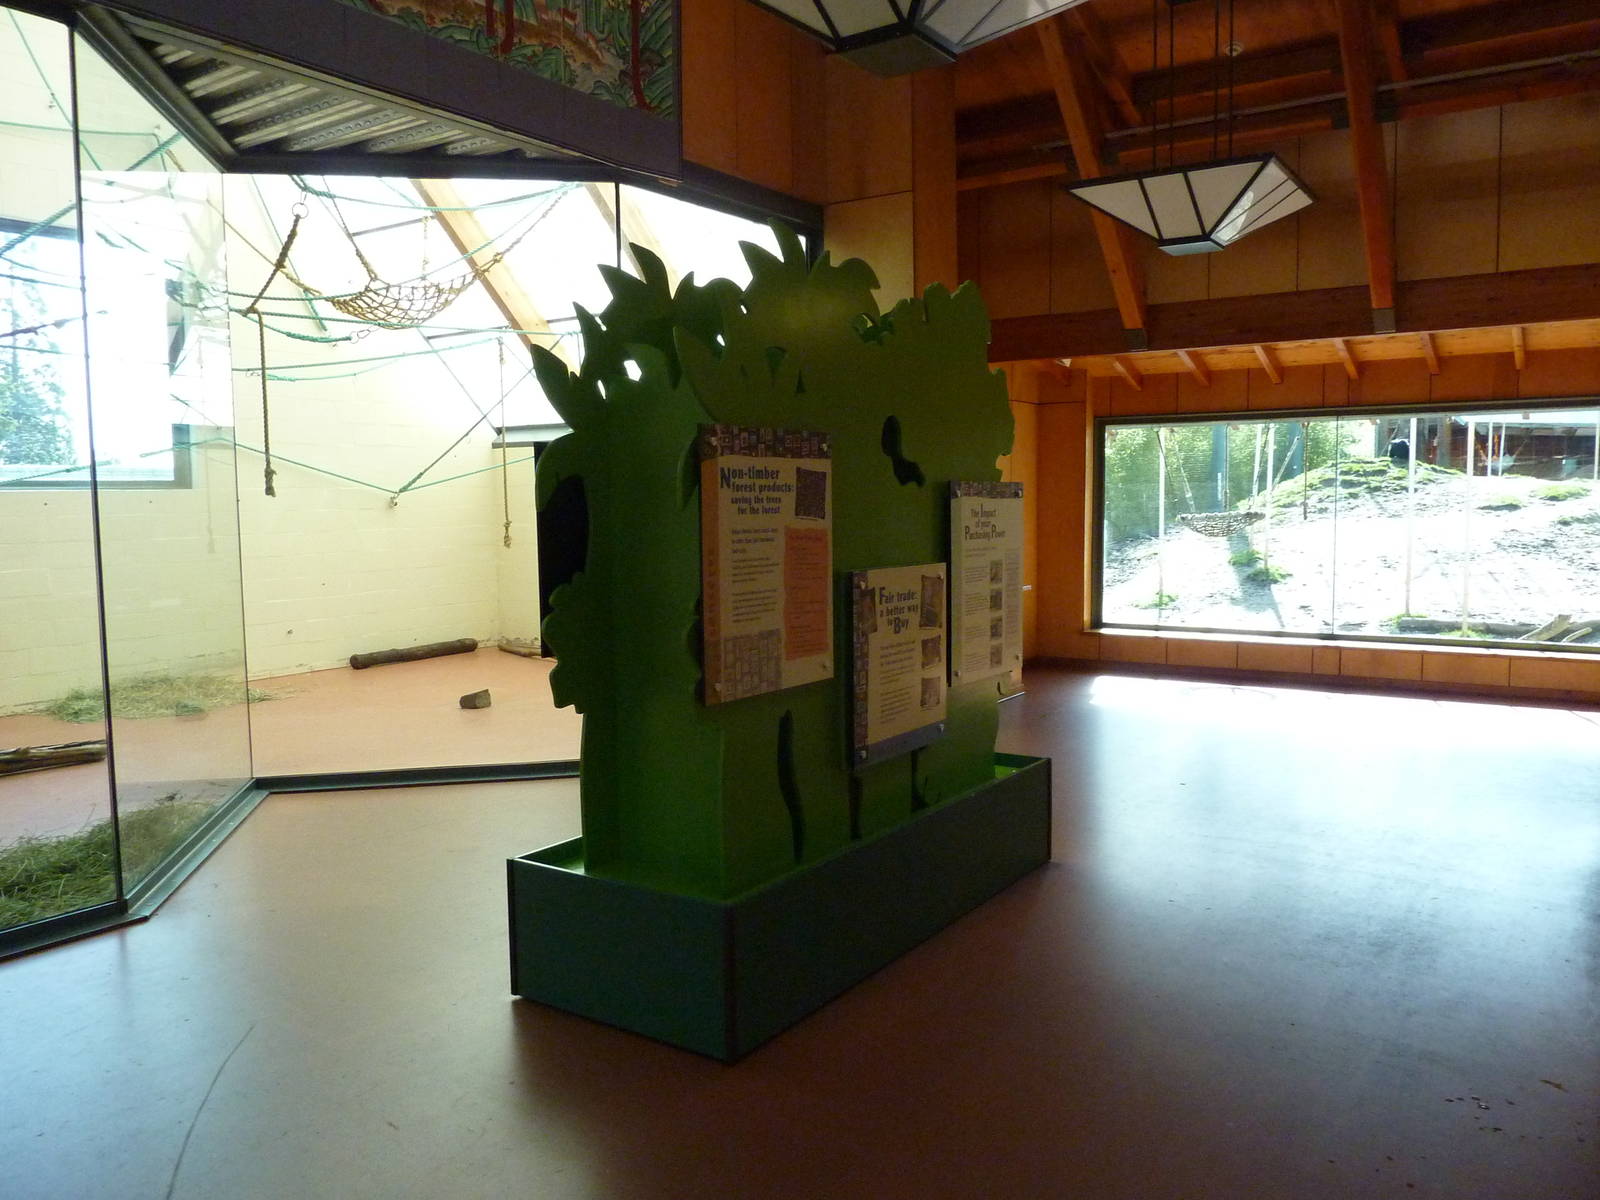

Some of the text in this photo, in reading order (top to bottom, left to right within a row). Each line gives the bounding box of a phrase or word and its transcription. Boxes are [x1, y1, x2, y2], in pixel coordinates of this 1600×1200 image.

[720, 465, 780, 489] Non-timber
[732, 482, 794, 495] forest products:
[754, 495, 764, 504] the
[737, 505, 748, 515] for
[749, 505, 760, 514] the
[879, 586, 894, 605] Fair
[886, 605, 905, 616] better
[894, 616, 909, 634] Buy
